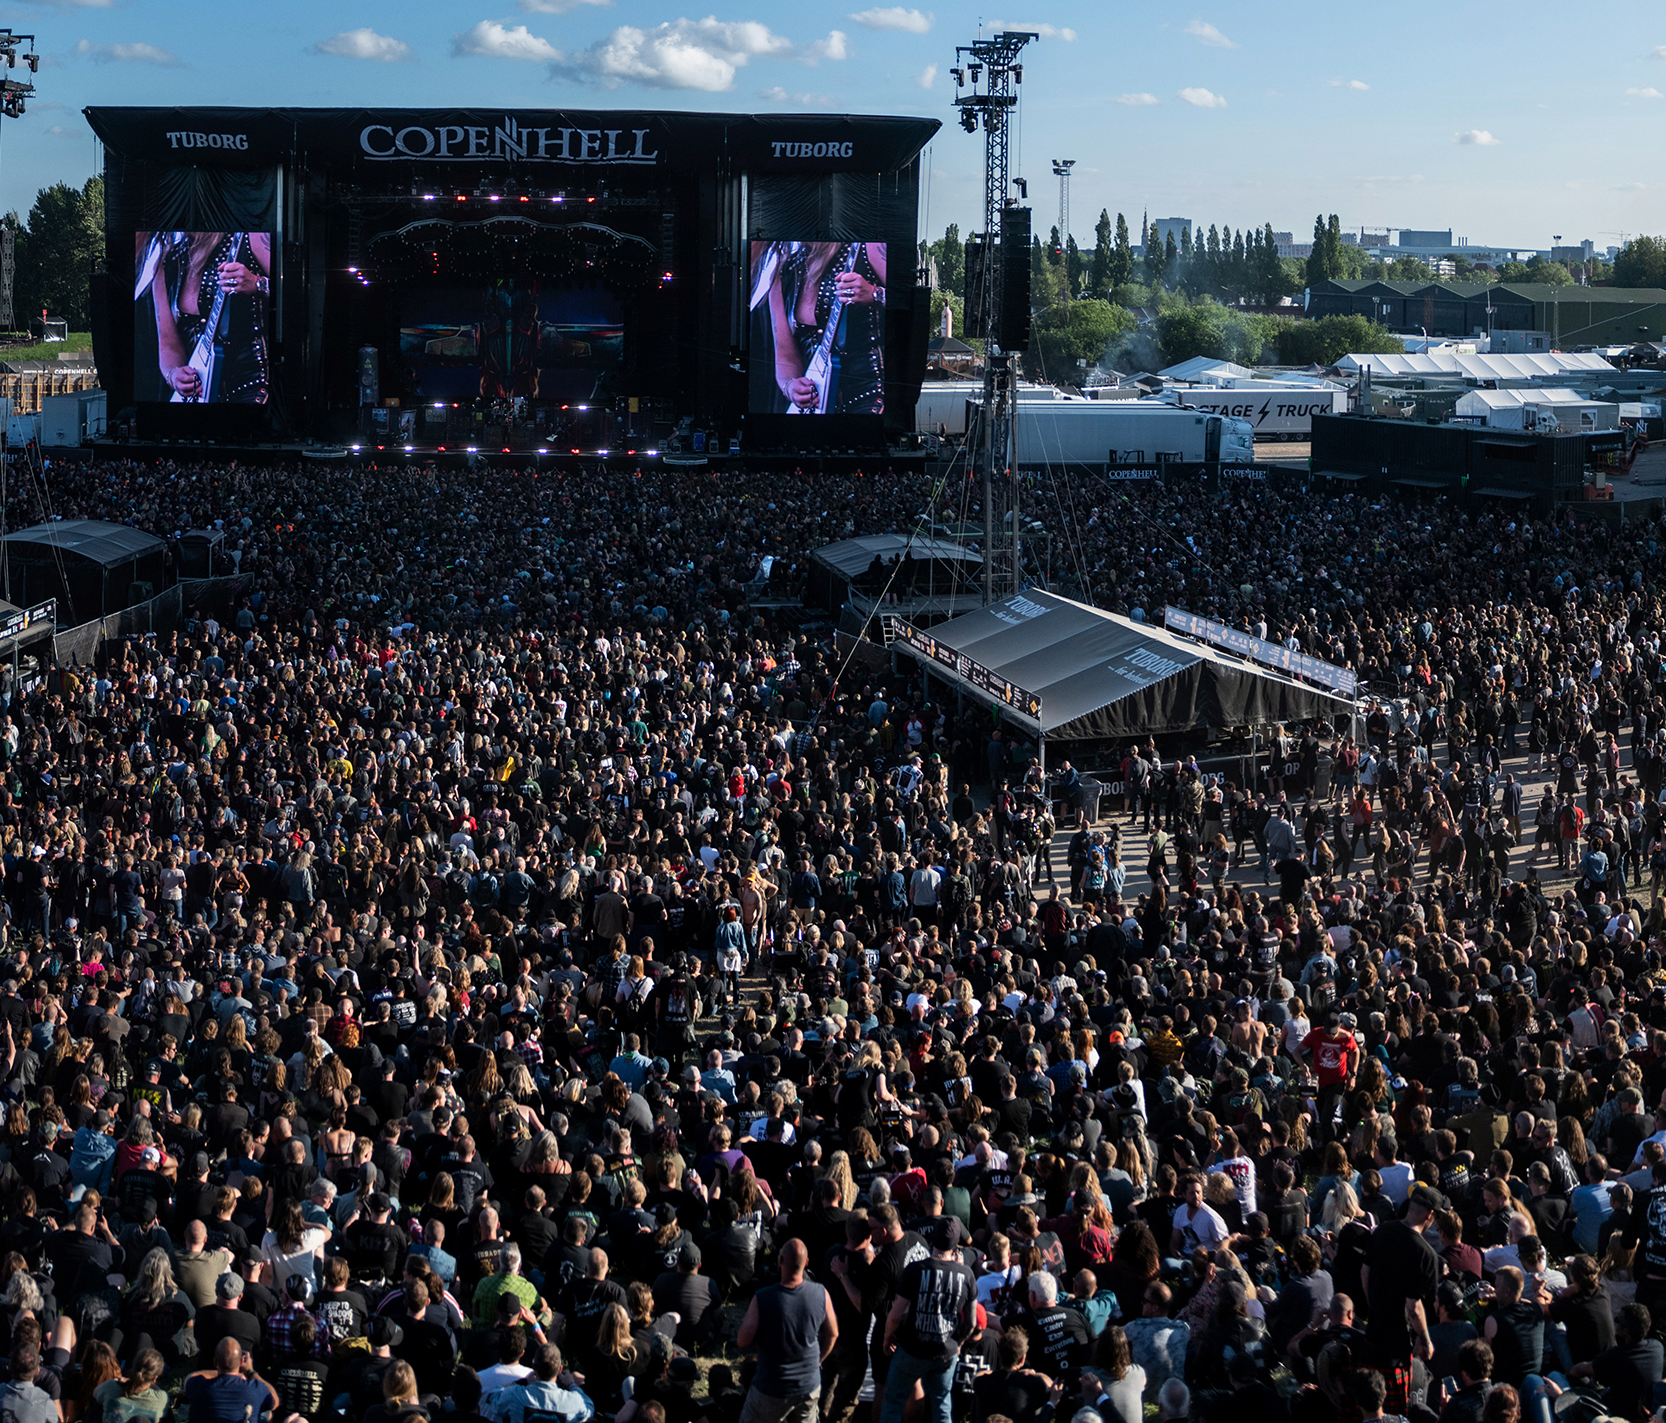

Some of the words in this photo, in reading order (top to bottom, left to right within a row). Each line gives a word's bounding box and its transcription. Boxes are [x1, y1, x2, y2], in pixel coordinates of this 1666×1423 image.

[166, 131, 249, 150] TUBORG
[359, 115, 658, 164] COPENHELL
[771, 141, 853, 157] TUBORG
[1199, 404, 1253, 418] STAGE
[1276, 404, 1332, 418] TRUCK
[1108, 469, 1159, 480] COPENHELL
[920, 1268, 965, 1294] MEAT
[917, 1291, 961, 1314] METAL
